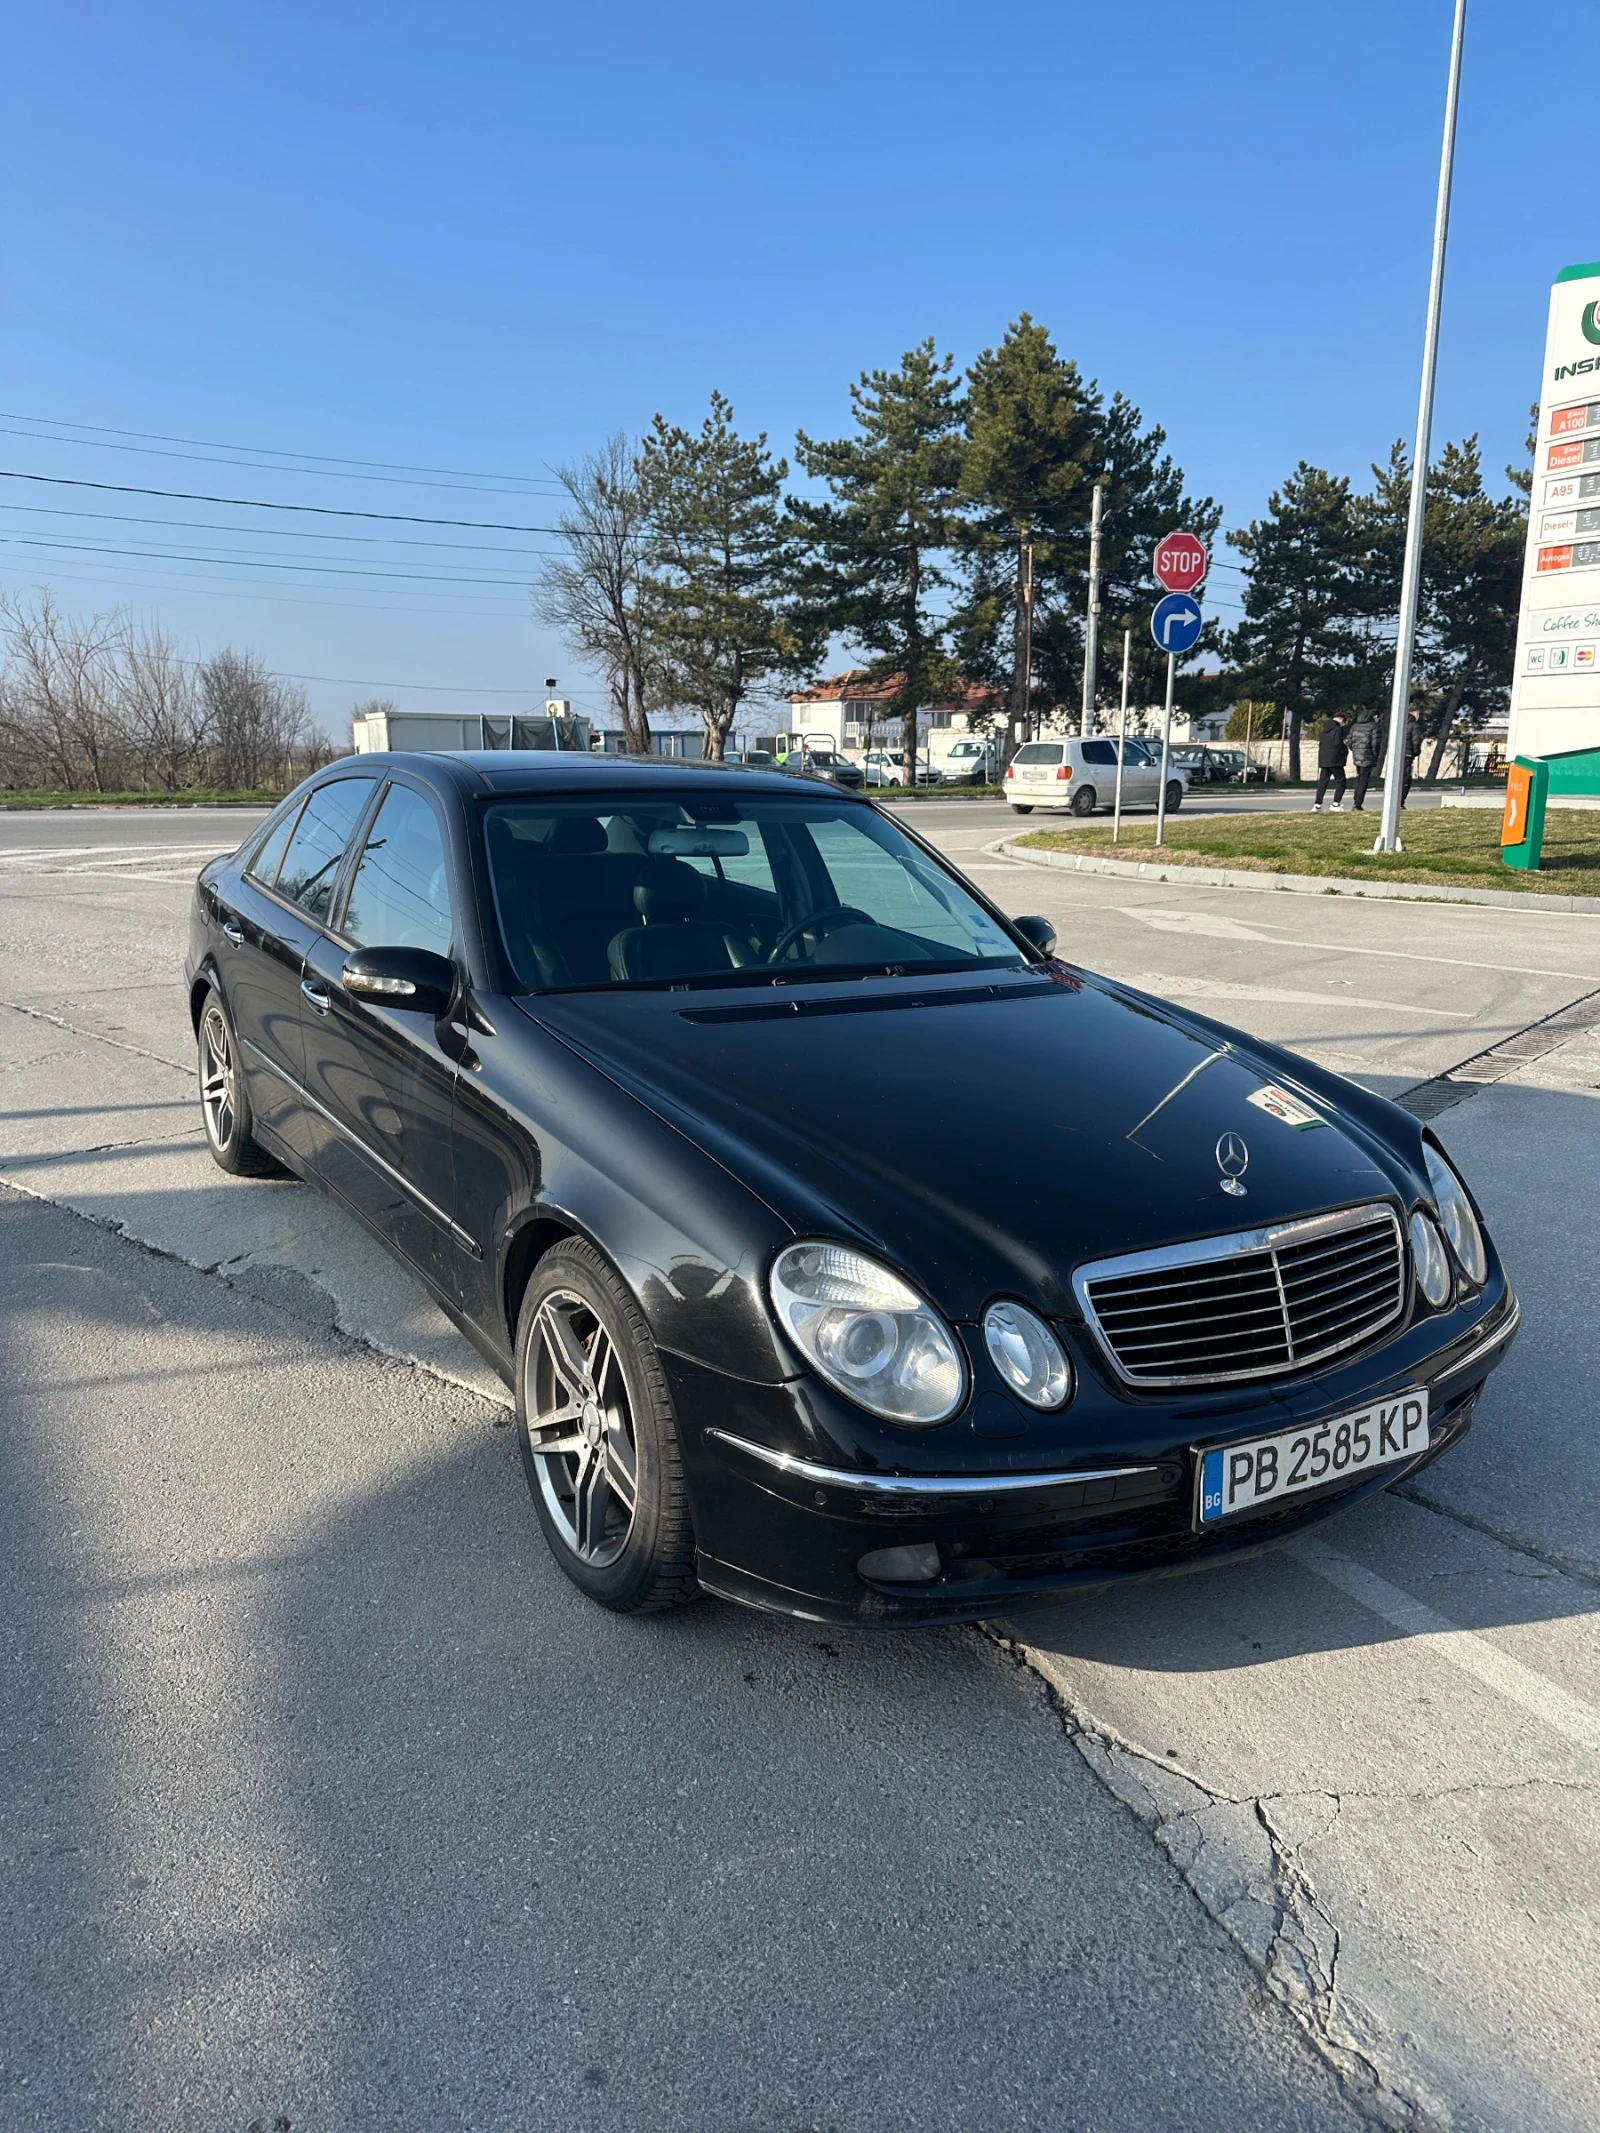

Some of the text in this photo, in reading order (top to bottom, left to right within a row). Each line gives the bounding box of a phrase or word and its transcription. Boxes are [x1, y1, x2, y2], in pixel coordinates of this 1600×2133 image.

[1558, 417, 1584, 431] A100
[1549, 453, 1581, 467] Diesel
[1551, 484, 1574, 498] A95
[1543, 520, 1574, 531] Diesel+
[1160, 551, 1202, 573] STOP
[1540, 553, 1571, 563] Autogas
[1543, 615, 1580, 632] Coffee
[1530, 655, 1543, 663] WC
[1204, 1400, 1422, 1511] BG PB 2585 KP
